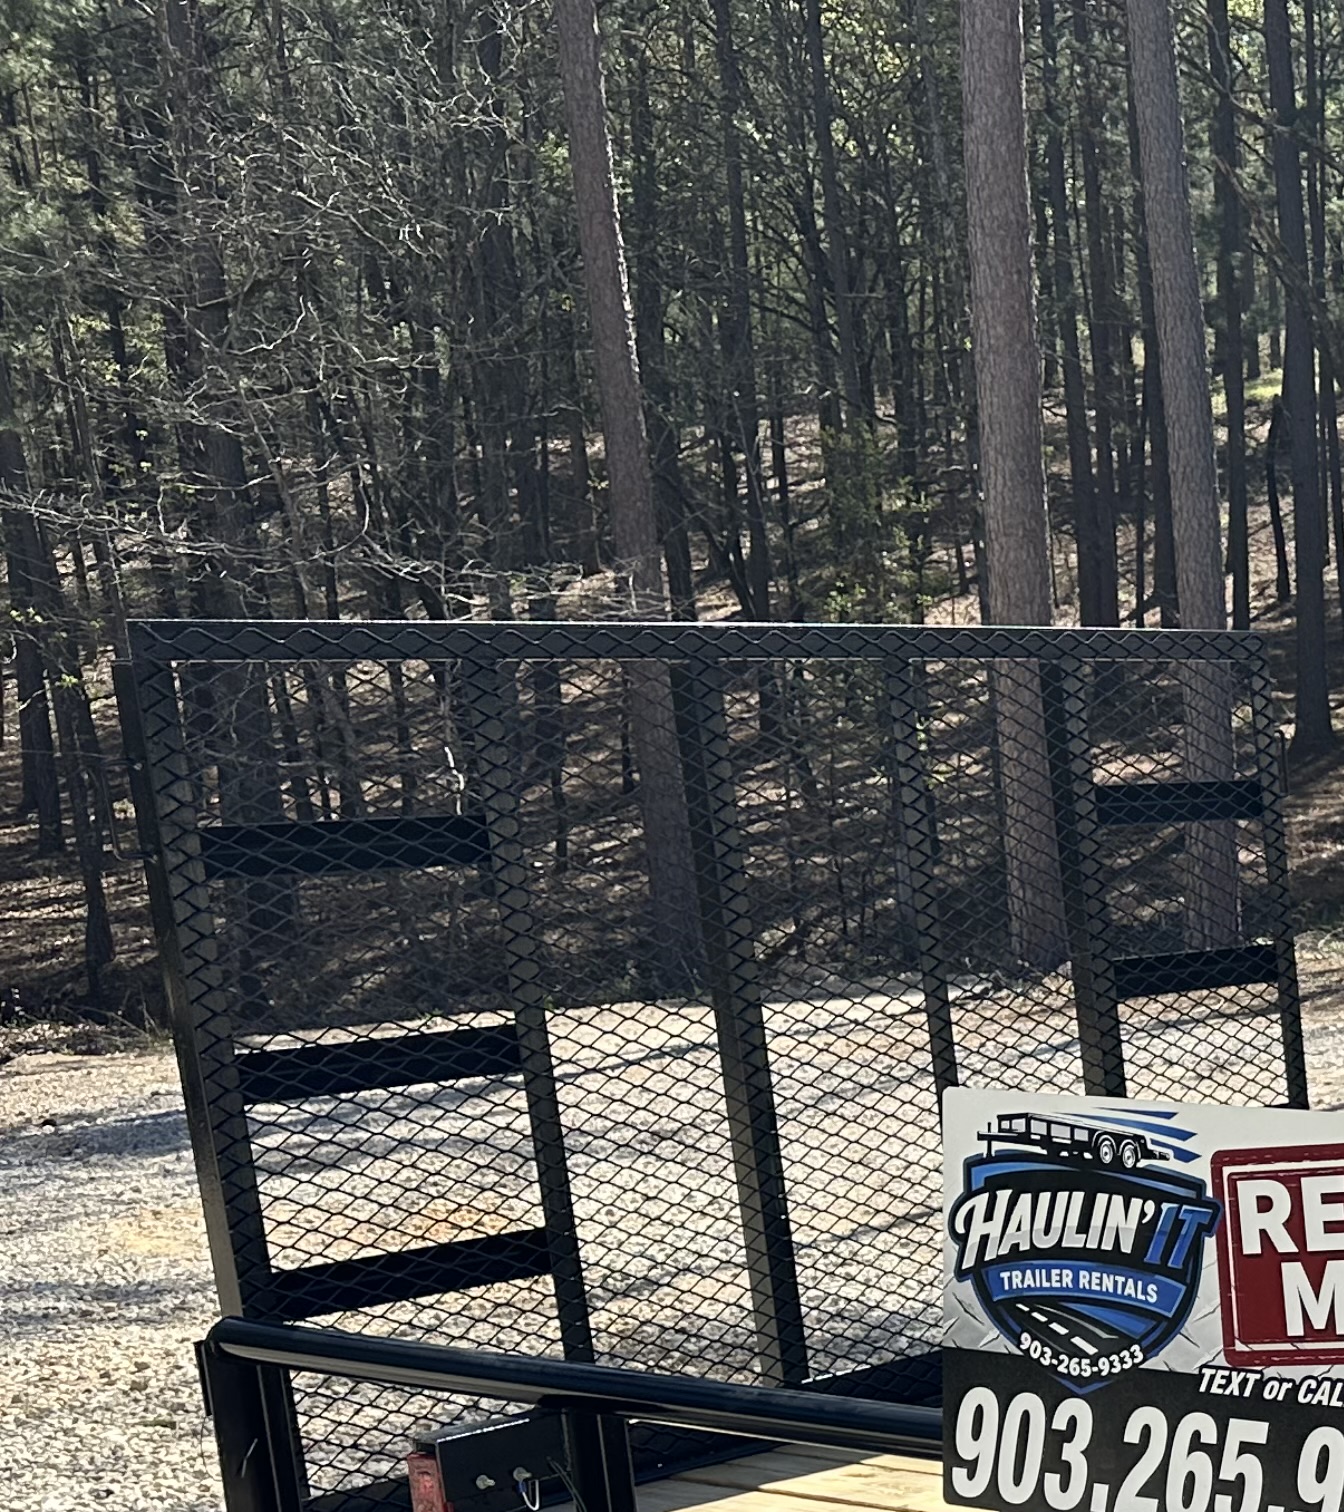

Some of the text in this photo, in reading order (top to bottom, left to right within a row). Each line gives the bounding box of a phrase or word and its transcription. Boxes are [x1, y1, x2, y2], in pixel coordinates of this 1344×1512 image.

[1000, 1268, 1159, 1304] TRAILER RENTALS
[1019, 1331, 1144, 1378] 903-265-9333
[1199, 1368, 1261, 1398] TEXT
[1263, 1380, 1292, 1401] or
